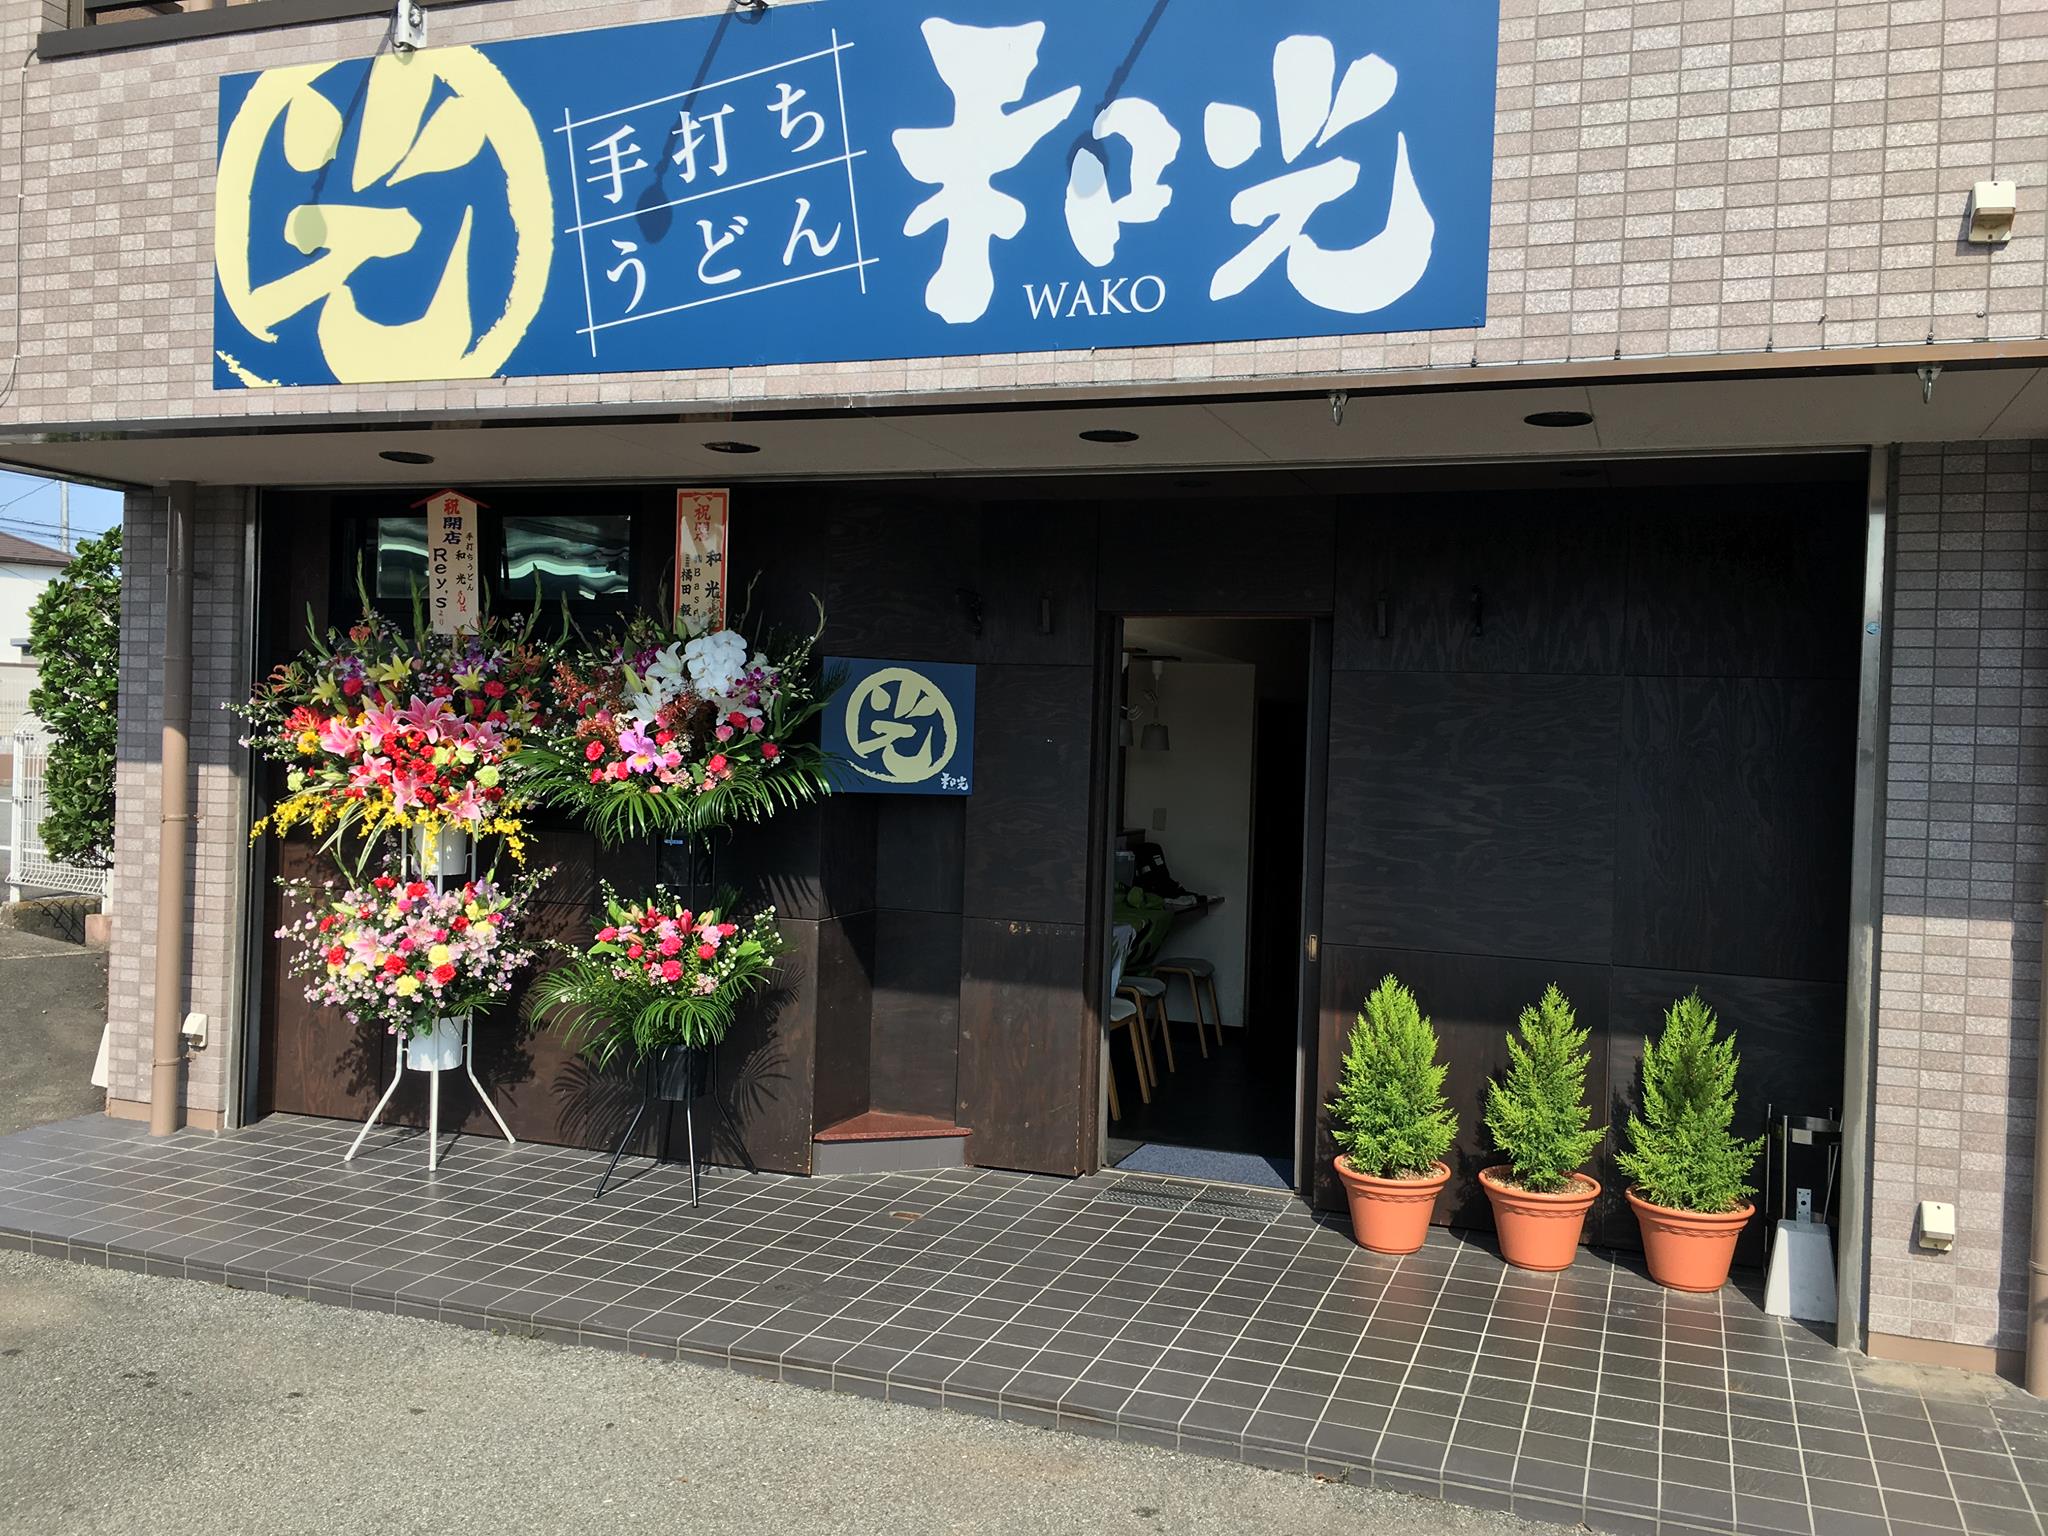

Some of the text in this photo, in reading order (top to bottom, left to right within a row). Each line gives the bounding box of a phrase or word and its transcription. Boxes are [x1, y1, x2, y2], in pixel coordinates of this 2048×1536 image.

[586, 82, 825, 204] 手打ち
[891, 17, 1436, 325] 和光
[605, 197, 842, 314] うどん
[1023, 275, 1167, 320] WAKO
